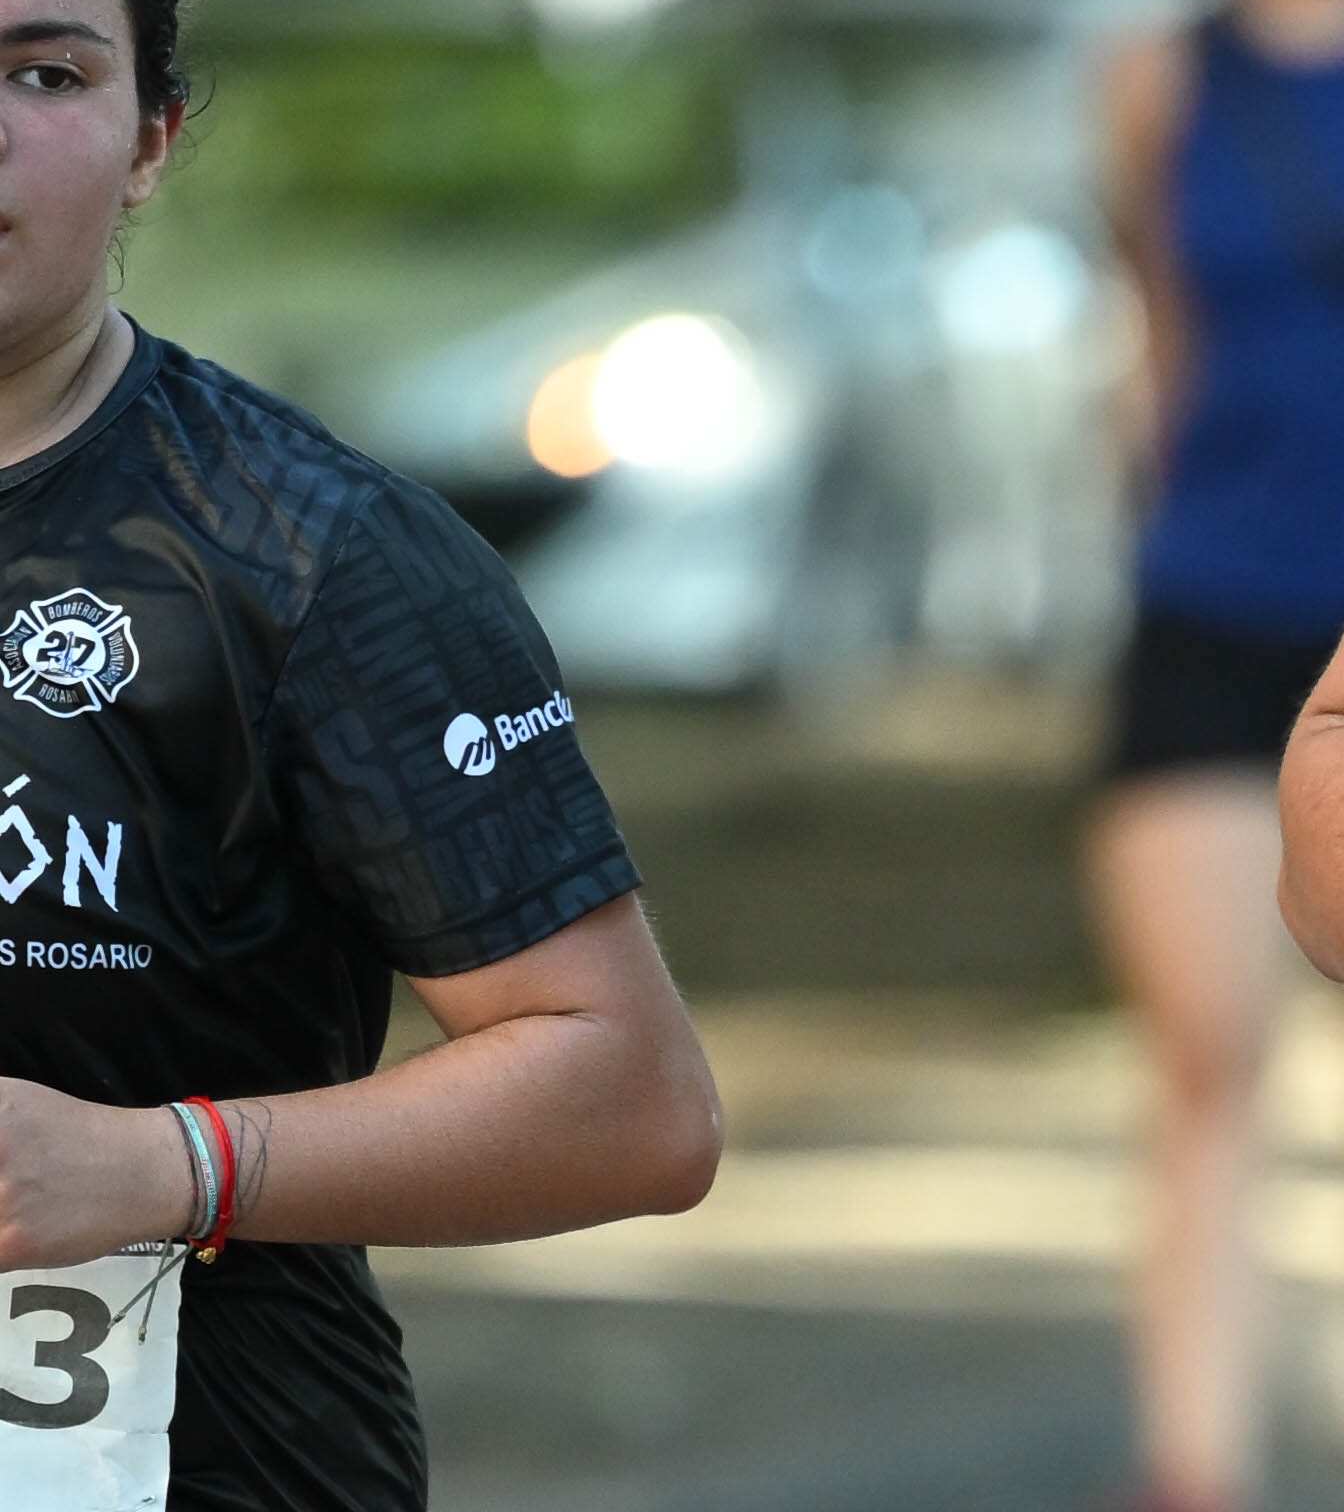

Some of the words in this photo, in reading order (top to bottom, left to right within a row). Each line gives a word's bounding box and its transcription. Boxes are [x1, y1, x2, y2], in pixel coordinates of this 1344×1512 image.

[47, 601, 104, 623] BOMBEROS
[36, 629, 97, 667] 27
[26, 940, 152, 970] ROSARIO
[0, 1284, 112, 1430] 3
